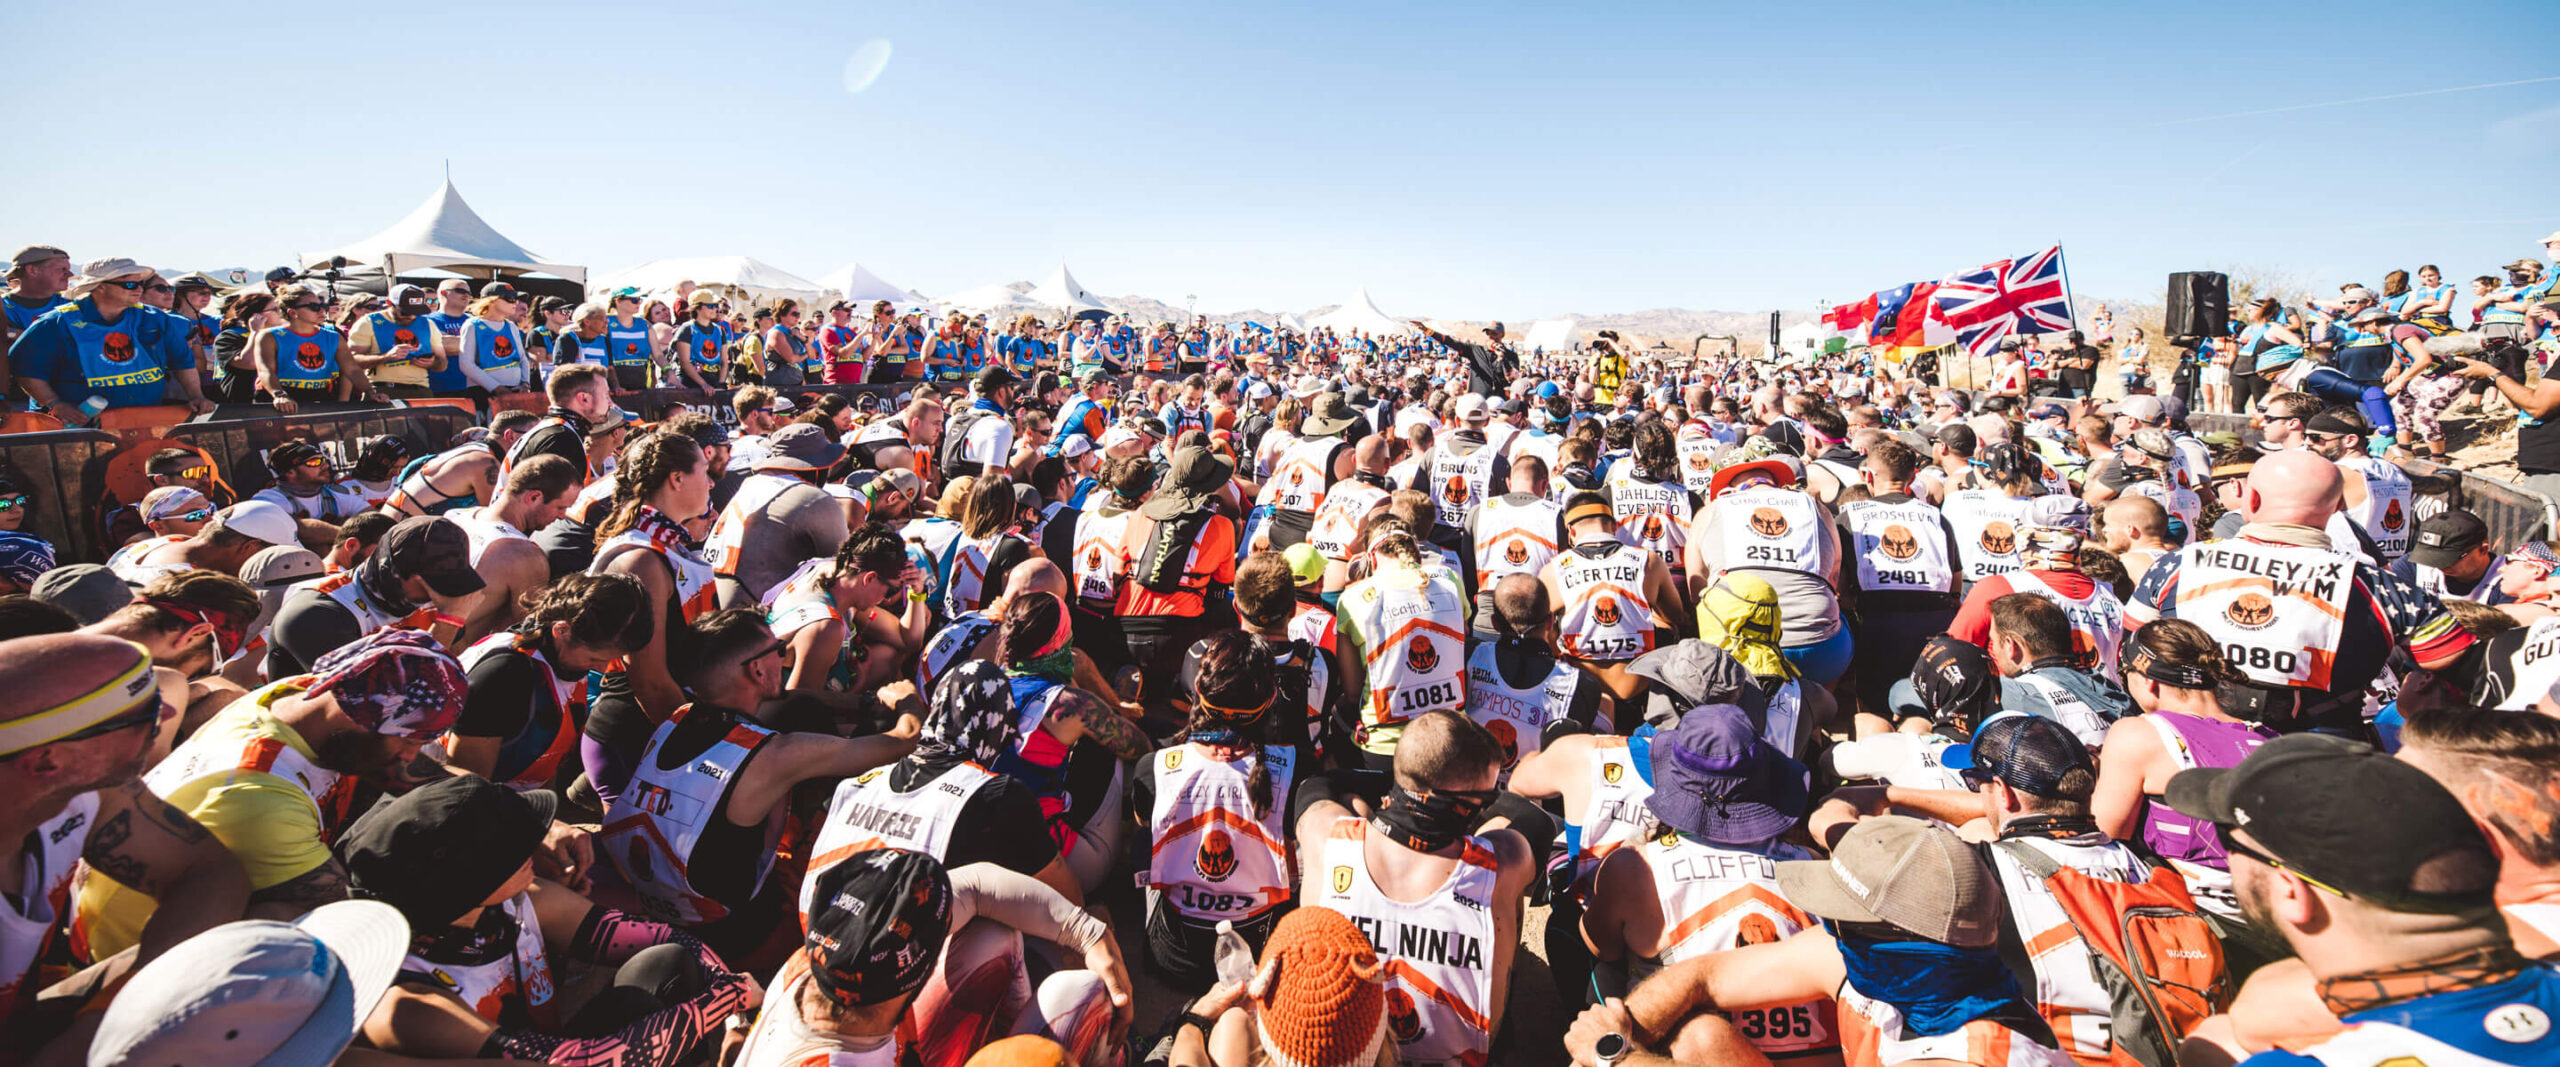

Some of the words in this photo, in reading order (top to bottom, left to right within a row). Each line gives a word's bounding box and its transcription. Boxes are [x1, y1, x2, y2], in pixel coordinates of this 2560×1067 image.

[91, 379, 119, 388] PIT
[123, 369, 163, 386] CREW
[1440, 463, 1479, 475] BRUNS
[1615, 488, 1679, 503] JAHLISA
[1151, 521, 1176, 583] NATHAN
[1746, 546, 1798, 563] 2511
[2195, 548, 2303, 581] MEDLEY
[1877, 570, 1931, 585] 2491
[1587, 637, 1637, 655] 1175
[2228, 643, 2297, 674] 080
[1401, 682, 1456, 711] 1081
[1545, 687, 1565, 702] 2021
[1266, 752, 1288, 768] 2021
[697, 762, 723, 781] 2021
[938, 782, 965, 797] 2021
[845, 802, 923, 841] HARRIS
[1181, 884, 1254, 912] 1087
[1453, 891, 1483, 912] 2021
[1398, 922, 1483, 971] NINJA
